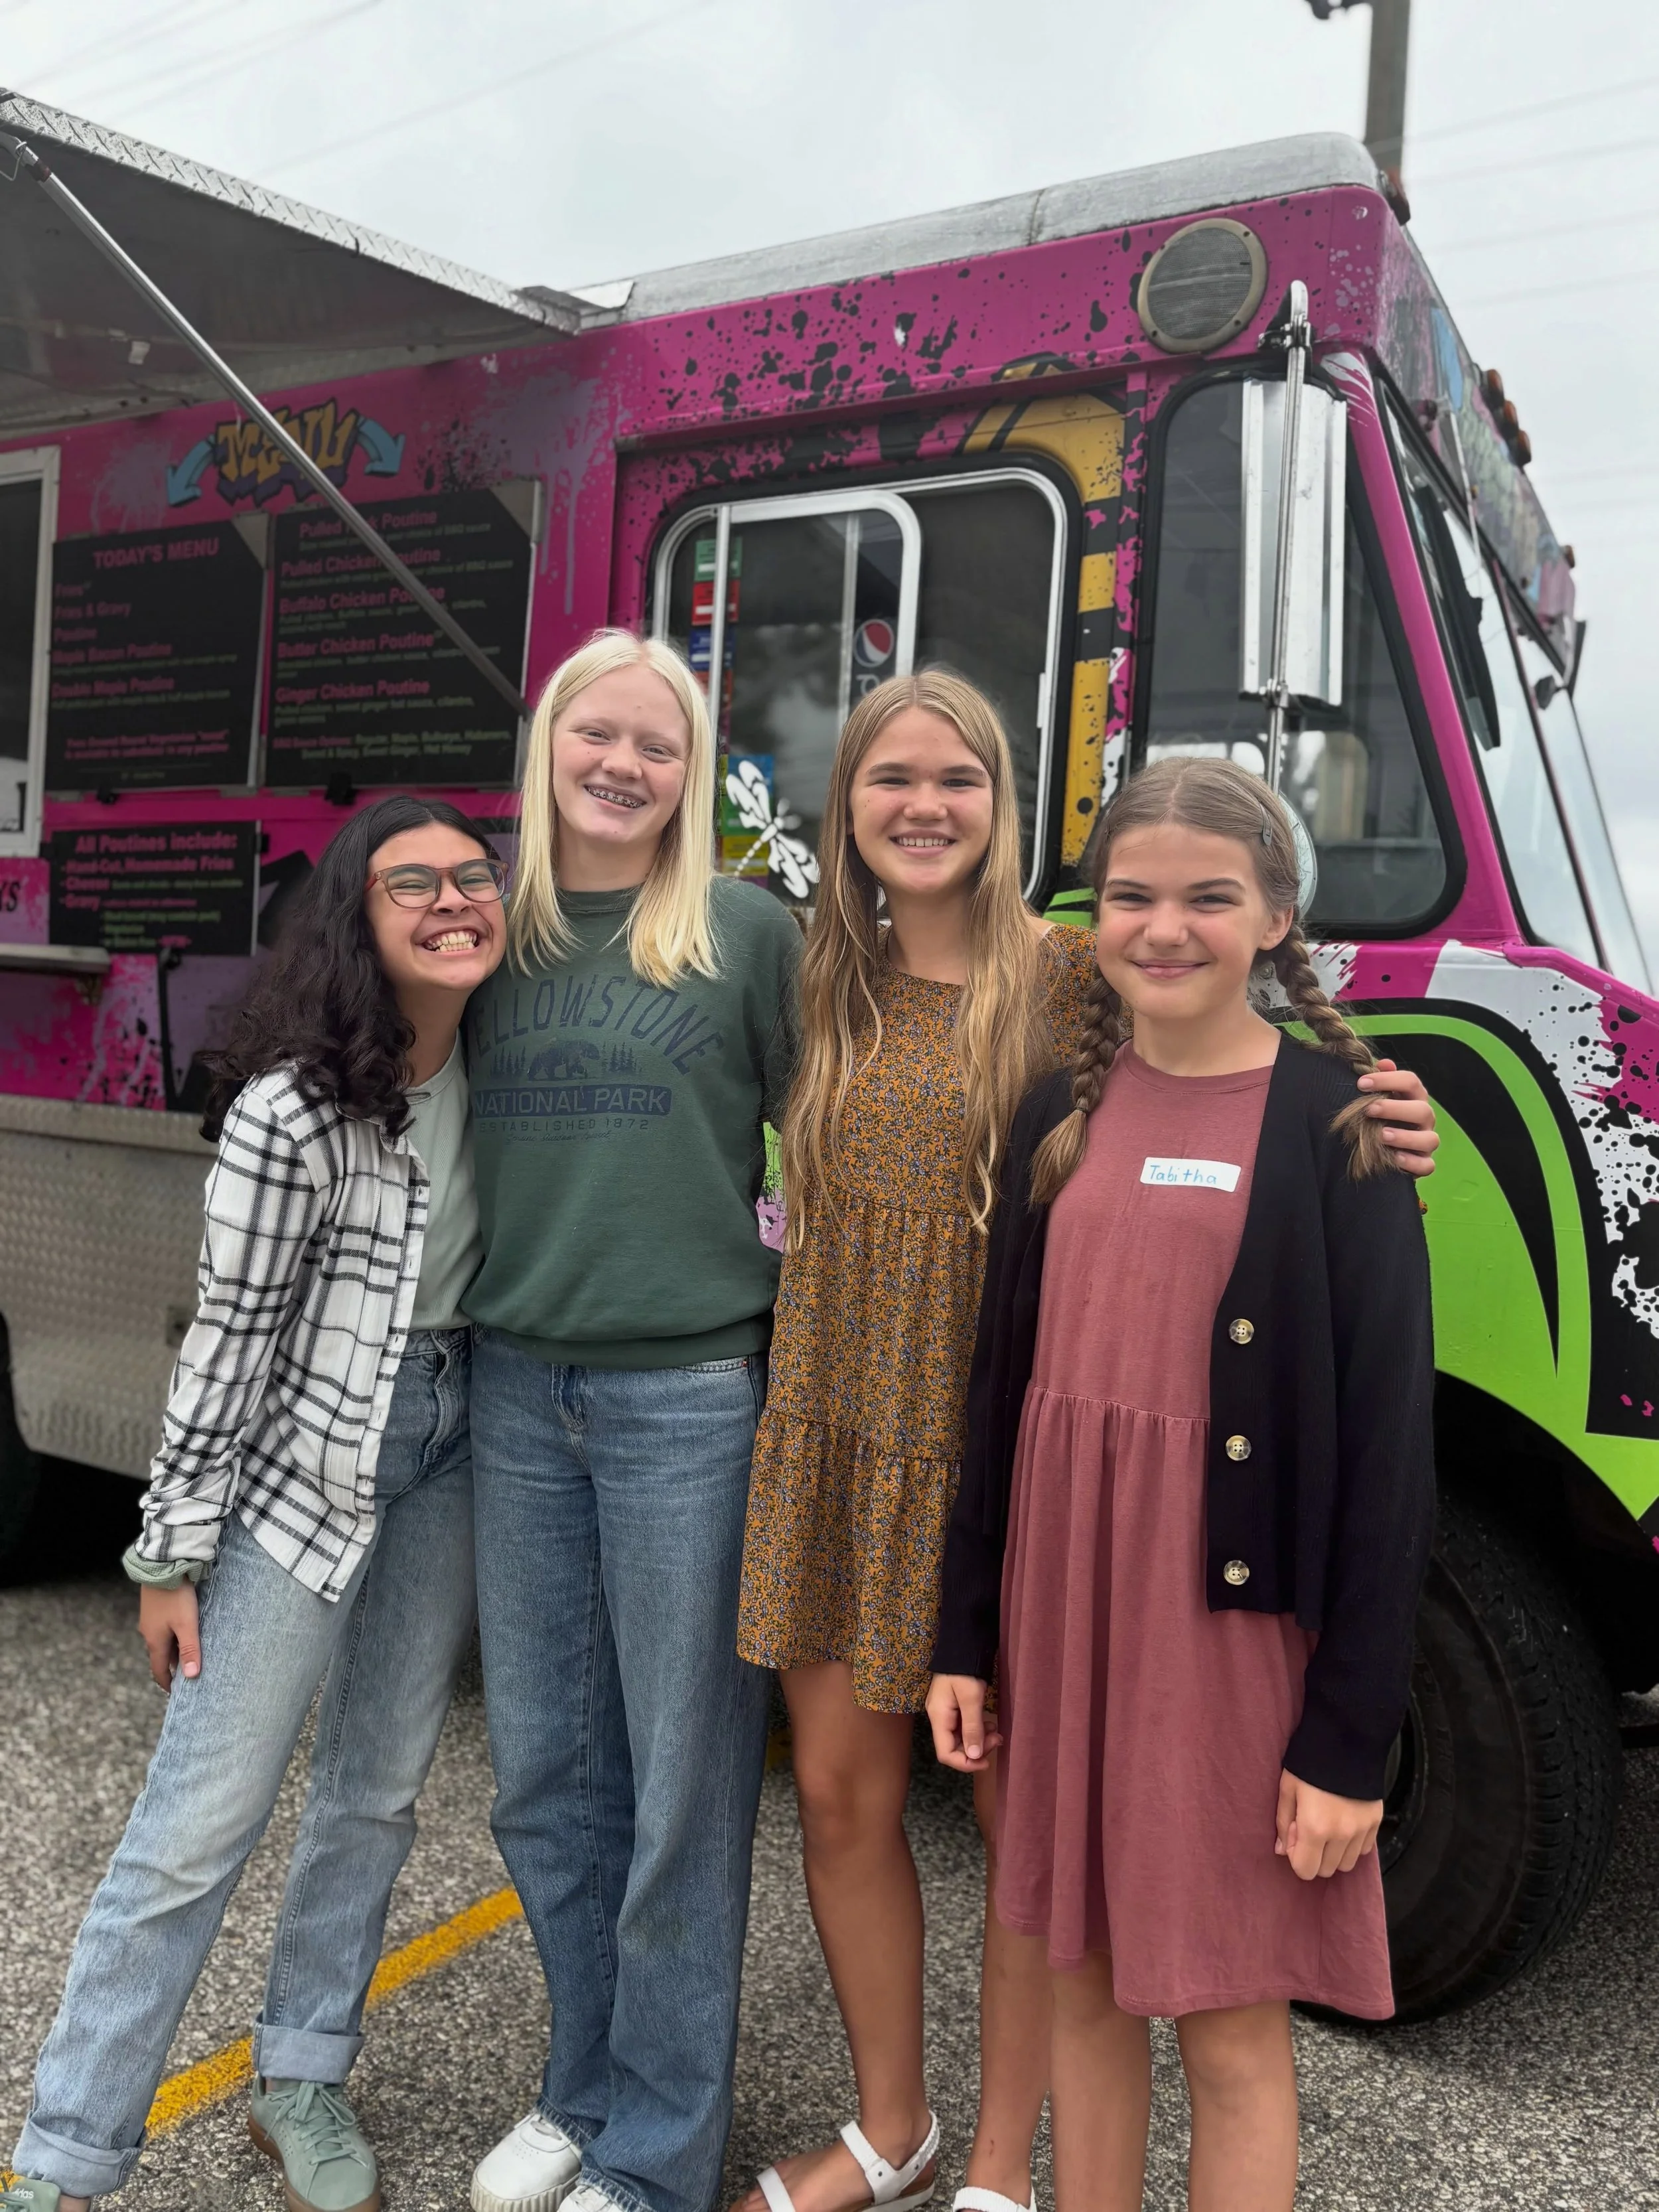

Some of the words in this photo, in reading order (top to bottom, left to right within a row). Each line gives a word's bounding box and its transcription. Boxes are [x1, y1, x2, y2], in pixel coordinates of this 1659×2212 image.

[300, 521, 342, 538] Pulled
[382, 510, 437, 530] Poutine
[93, 544, 165, 569] TODAY'S
[167, 537, 220, 561] MENU
[281, 559, 322, 577] Pulled
[326, 553, 380, 572] Chicken
[398, 547, 441, 566] outine
[279, 595, 326, 615] Buffalo
[330, 591, 386, 609] Chicken
[277, 640, 318, 658] Butter
[321, 636, 376, 654] Chicken
[379, 631, 434, 650] Poutine
[275, 686, 318, 705] Ginger
[321, 683, 374, 700] Chicken
[377, 678, 430, 696] Poutine
[75, 834, 97, 854] All
[100, 833, 167, 853] Poutines
[170, 830, 238, 850] include:
[200, 854, 234, 871] Fries
[474, 974, 724, 1075] ELLOWSTONE
[474, 1087, 587, 1116] NATIONAL
[594, 1086, 667, 1114] PARK
[480, 1118, 596, 1133] ESTABLISHED
[605, 1118, 649, 1131] 1872
[1150, 1164, 1216, 1185] Tabitha
